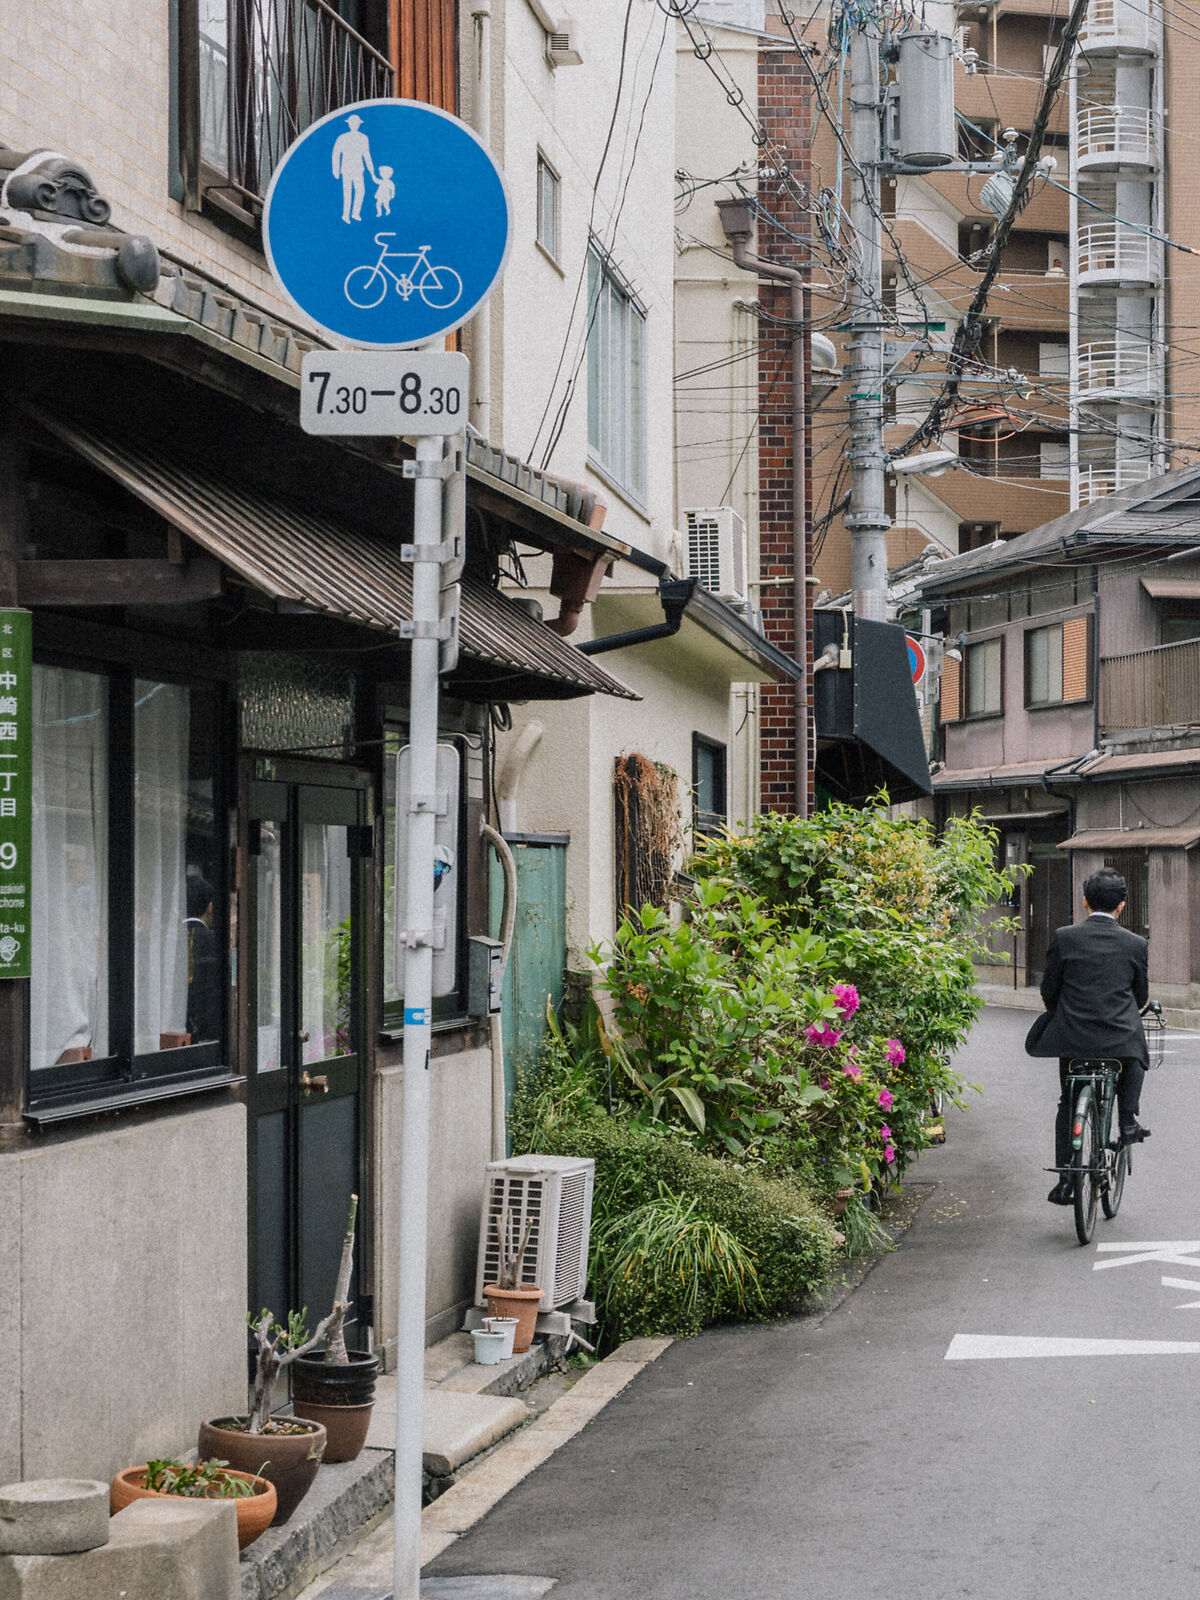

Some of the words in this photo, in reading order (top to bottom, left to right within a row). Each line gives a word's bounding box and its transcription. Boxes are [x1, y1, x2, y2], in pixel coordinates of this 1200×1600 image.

[2, 624, 13, 659] 北区
[0, 671, 18, 817] 中崎西一丁目
[0, 842, 17, 870] 9
